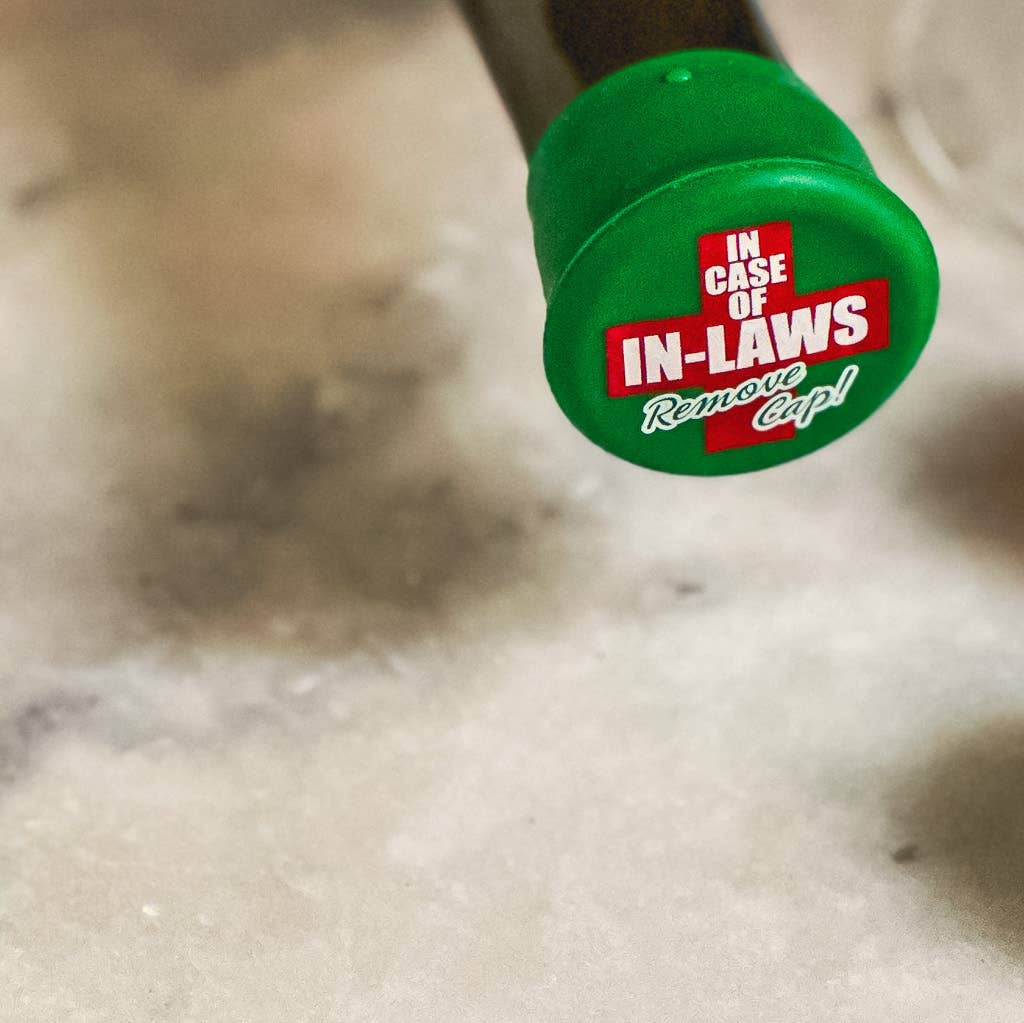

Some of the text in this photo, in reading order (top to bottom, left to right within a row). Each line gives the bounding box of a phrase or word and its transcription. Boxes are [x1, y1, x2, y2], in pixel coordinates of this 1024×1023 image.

[726, 229, 760, 263] IN
[704, 253, 787, 296] CASE
[728, 287, 767, 320] OF
[622, 295, 868, 387] IN-LAWS
[642, 363, 806, 432] Remove
[753, 365, 858, 428] Cap!
